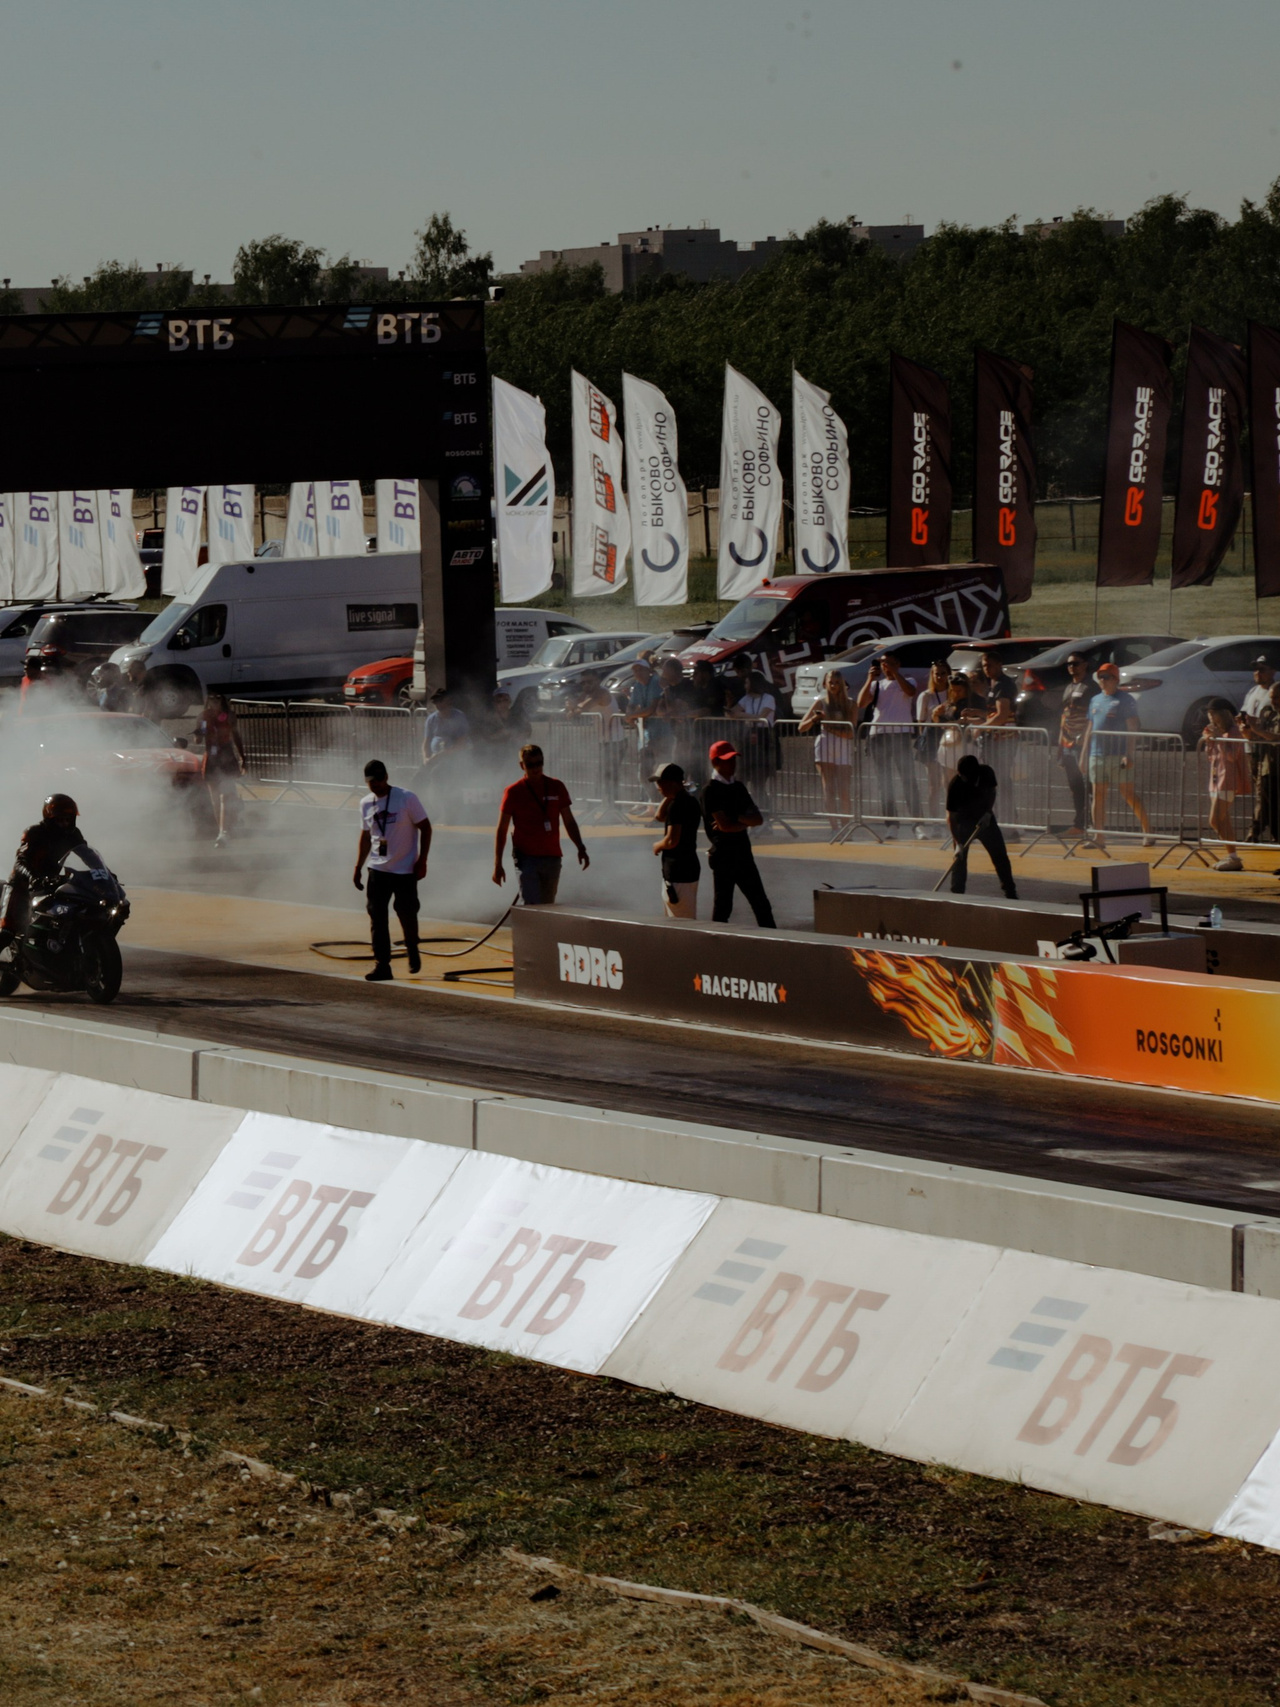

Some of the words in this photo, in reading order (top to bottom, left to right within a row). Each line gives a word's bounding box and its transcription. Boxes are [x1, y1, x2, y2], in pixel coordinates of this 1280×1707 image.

[168, 318, 235, 352] ВТБ
[377, 312, 442, 345] ВТБ
[453, 373, 477, 385] ВТБ
[454, 412, 477, 425] ВТБ
[654, 412, 676, 493] СОФЬИНО
[756, 406, 771, 486] СОФЬИНО
[822, 405, 839, 491] СОФЬИНО
[110, 489, 121, 517] ВТ
[181, 485, 202, 515] ВТ
[223, 484, 243, 518] ВТ
[330, 480, 350, 511] ВТ
[394, 478, 416, 520] ВТ
[649, 456, 664, 527] БЫКОВО
[742, 450, 755, 521] БЫКОВО
[811, 452, 825, 526] БЫКОВО
[29, 491, 49, 522] ВТ
[73, 490, 94, 524] ВТ
[349, 609, 366, 623] live
[367, 608, 396, 623] signal
[557, 942, 624, 990] RDRC
[702, 974, 778, 1004] RACEPARK
[1136, 1029, 1223, 1063] ROSGONKI
[44, 1134, 168, 1228] ВТБ
[236, 1179, 376, 1280] ВТБ
[457, 1227, 617, 1336] ВТБ
[715, 1272, 891, 1393] ВТБ
[1015, 1333, 1214, 1468] ВТБ
